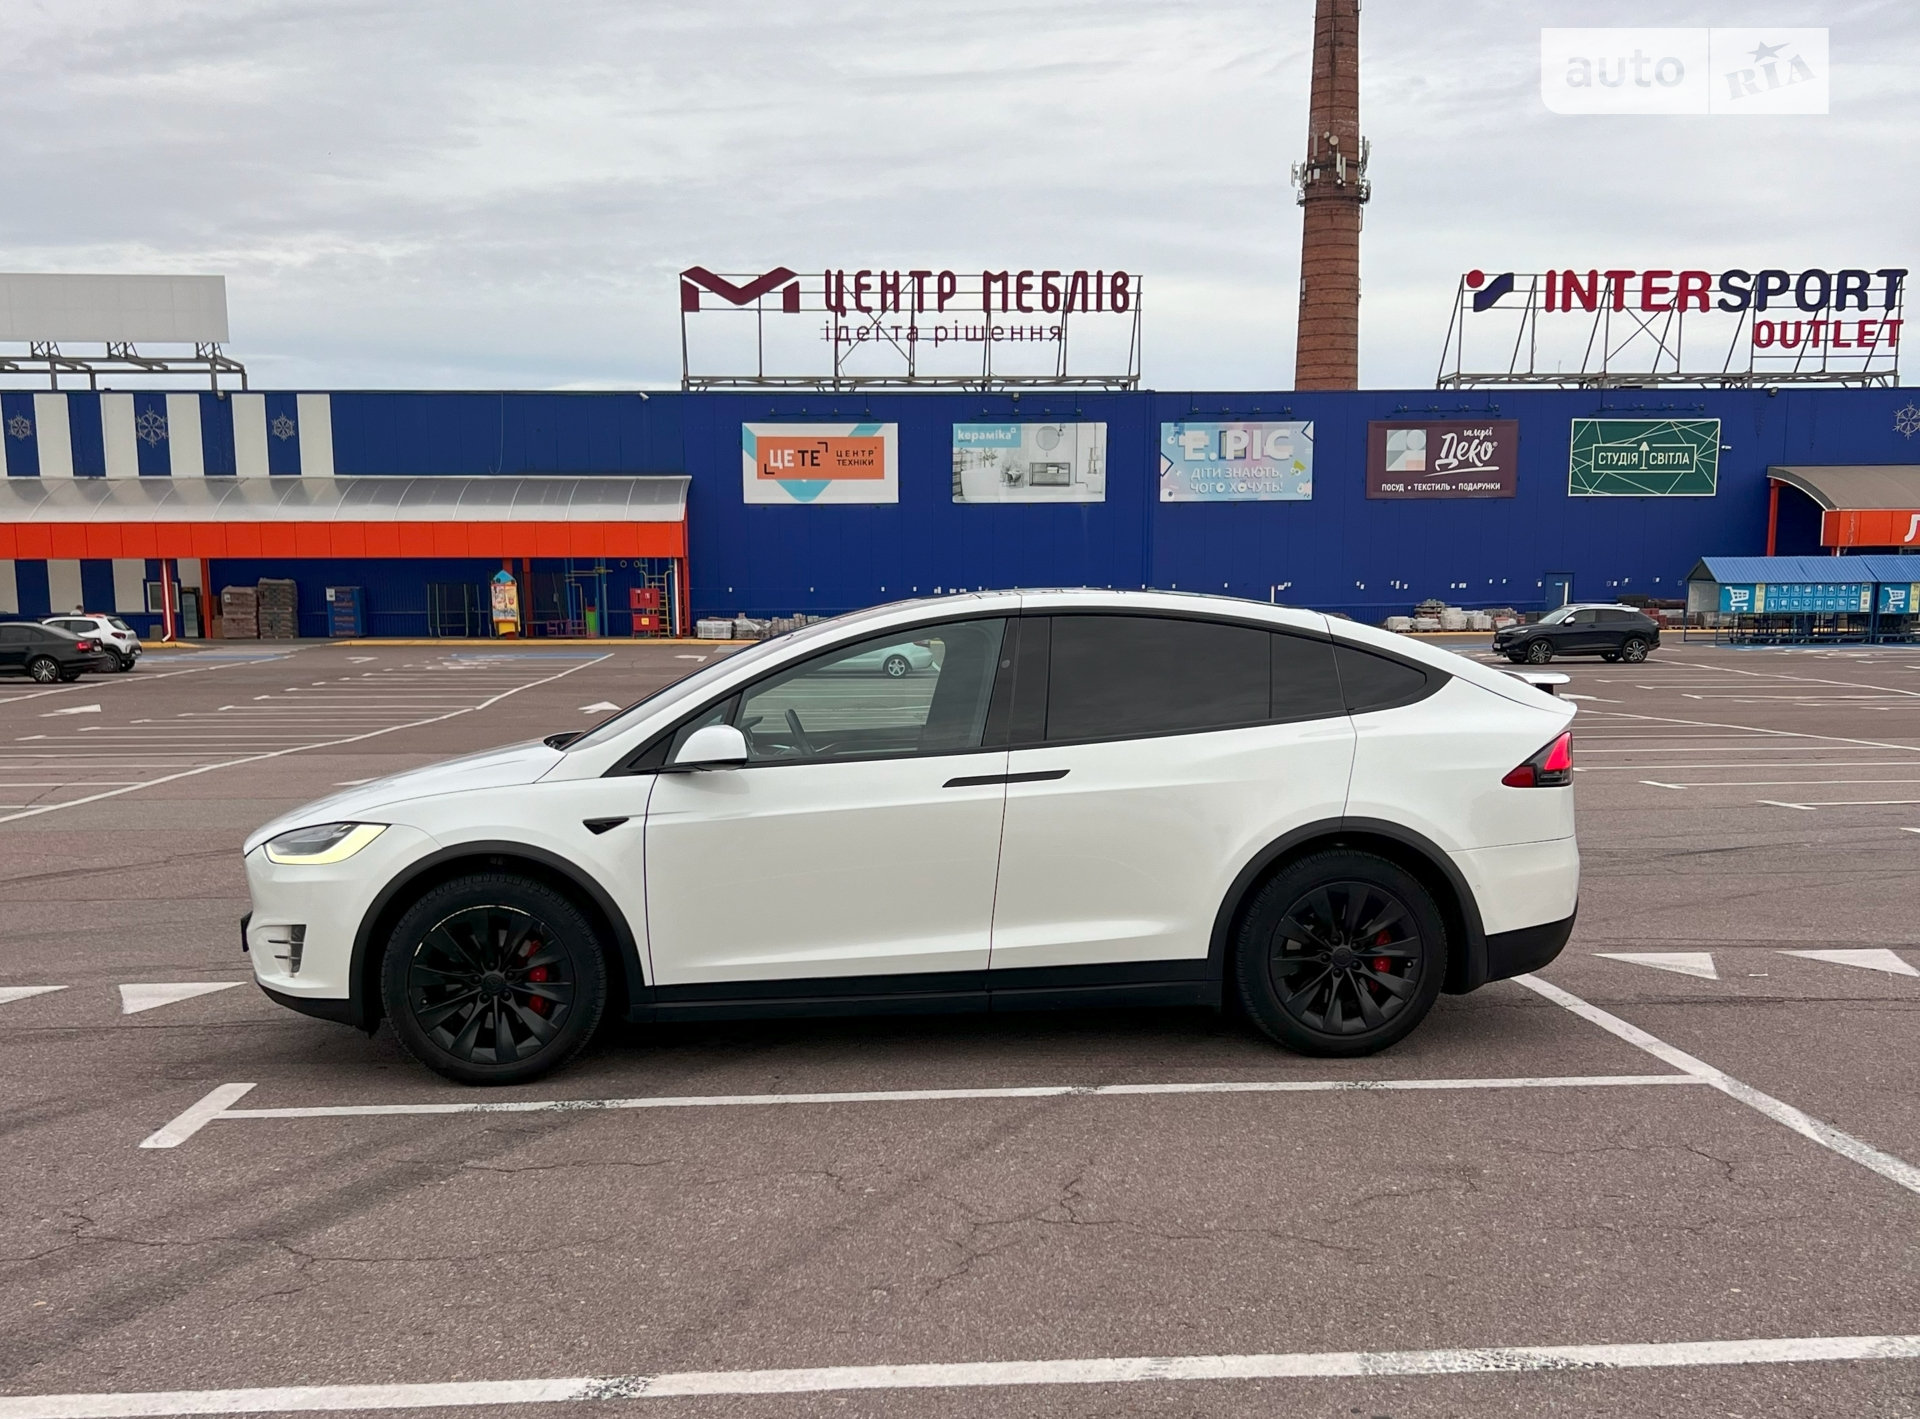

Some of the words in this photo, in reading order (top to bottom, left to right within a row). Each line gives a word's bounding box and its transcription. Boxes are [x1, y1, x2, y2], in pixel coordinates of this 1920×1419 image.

[824, 269, 957, 317] ЦЕНТР
[983, 270, 1130, 313] МЕБЛІВ
[1545, 268, 1909, 313] INTERSPORT
[934, 319, 1062, 348] рішення
[1754, 319, 1905, 348] OUTLET
[836, 449, 875, 458] ЦЕНТР
[1435, 432, 1495, 471] Деко
[1598, 452, 1639, 466] СТУДІЯ
[1649, 451, 1690, 465] СВІТЛА
[836, 458, 875, 467] ТЕХНІКИ
[1190, 467, 1222, 482] ДІТИ
[1190, 482, 1226, 494] ЧОГО
[1381, 483, 1405, 492] ПОСУД
[1413, 483, 1451, 491] ТЕКСТИЛЬ
[1458, 482, 1501, 491] ПОДАРУНКИ
